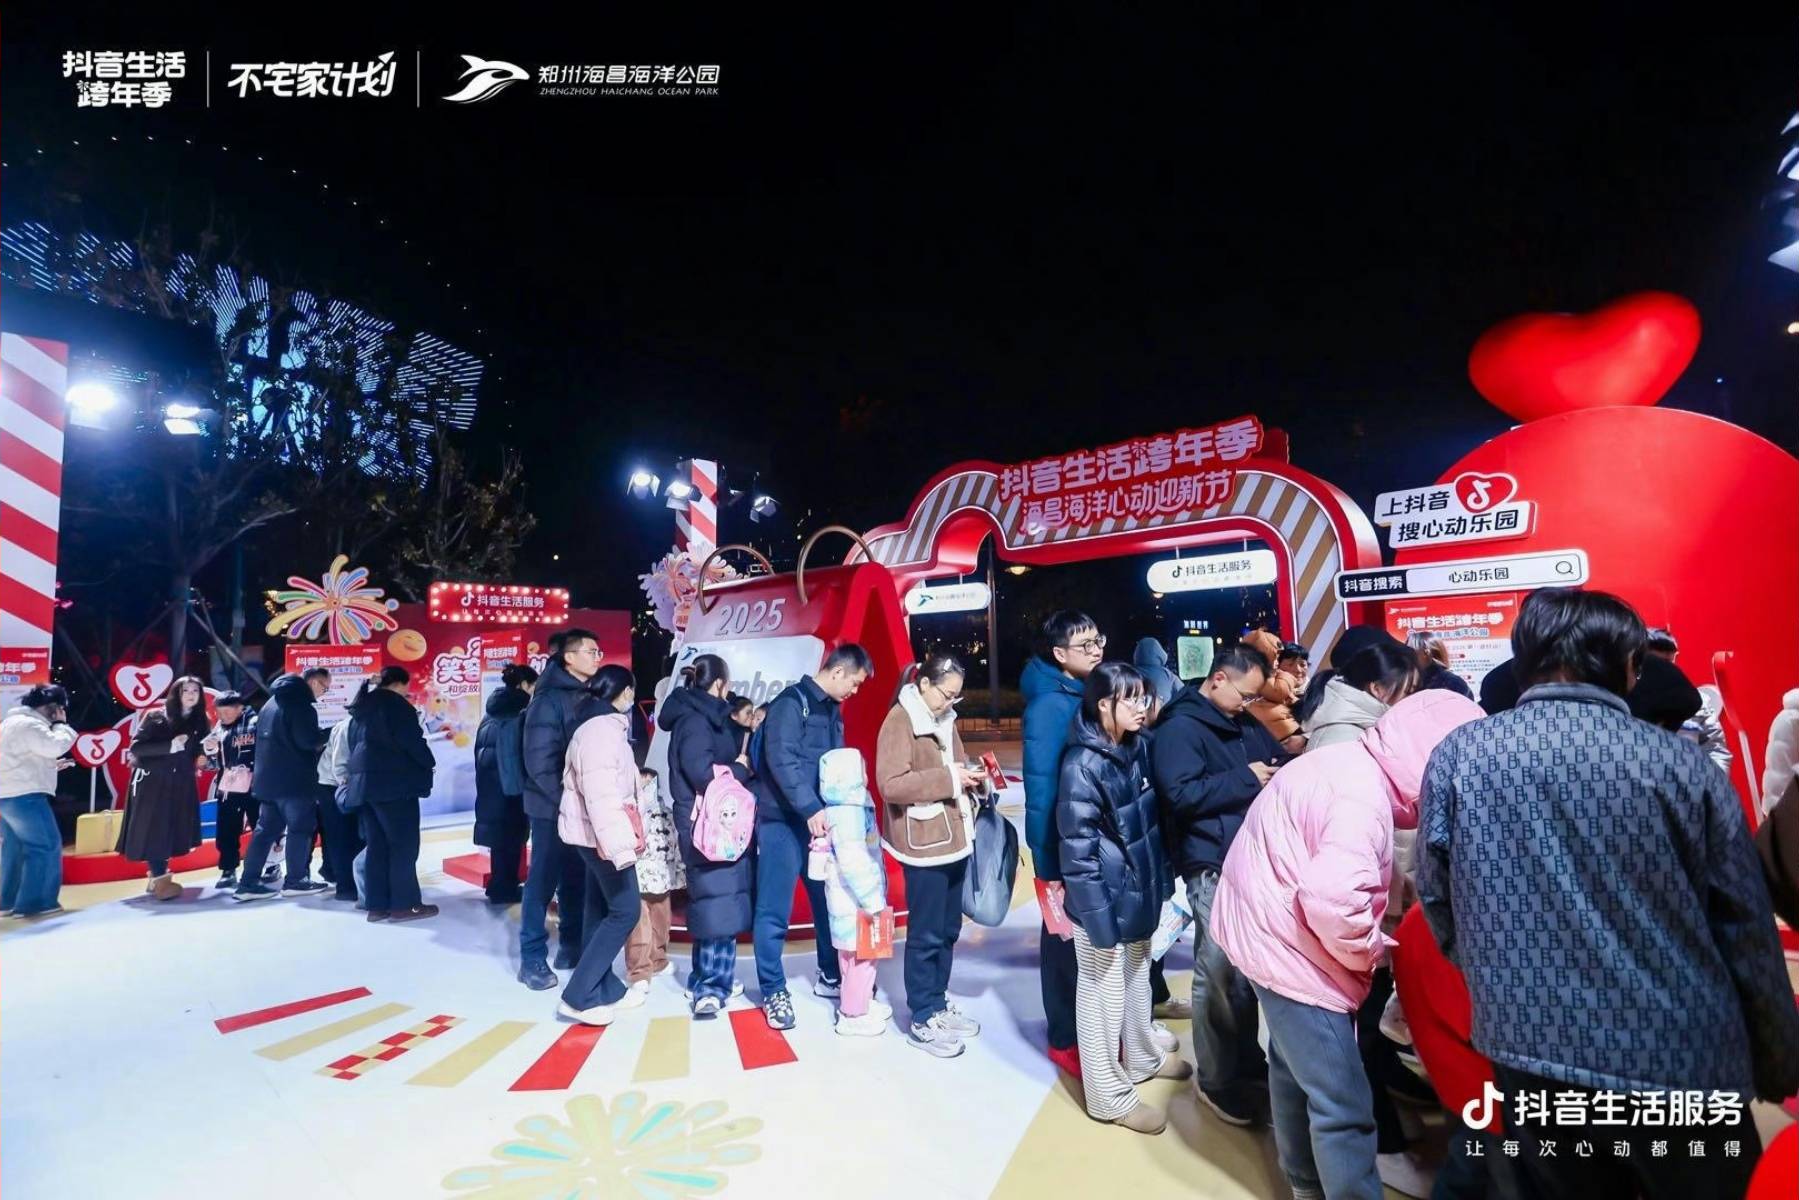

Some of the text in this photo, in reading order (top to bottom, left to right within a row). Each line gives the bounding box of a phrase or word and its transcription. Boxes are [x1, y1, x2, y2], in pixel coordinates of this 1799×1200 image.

[1000, 418, 1259, 501] 抖音生活跨年季
[1022, 468, 1233, 530] 海昌海洋心动迎新节
[1381, 490, 1451, 518] 上抖音
[1397, 508, 1519, 543] 搜心动乐园
[1185, 559, 1252, 577] 抖音生活服务
[1448, 567, 1510, 584] 心动乐园
[1343, 575, 1404, 593] 抖音搜索
[477, 594, 545, 608] 抖音生活服务
[715, 598, 786, 637] 2025
